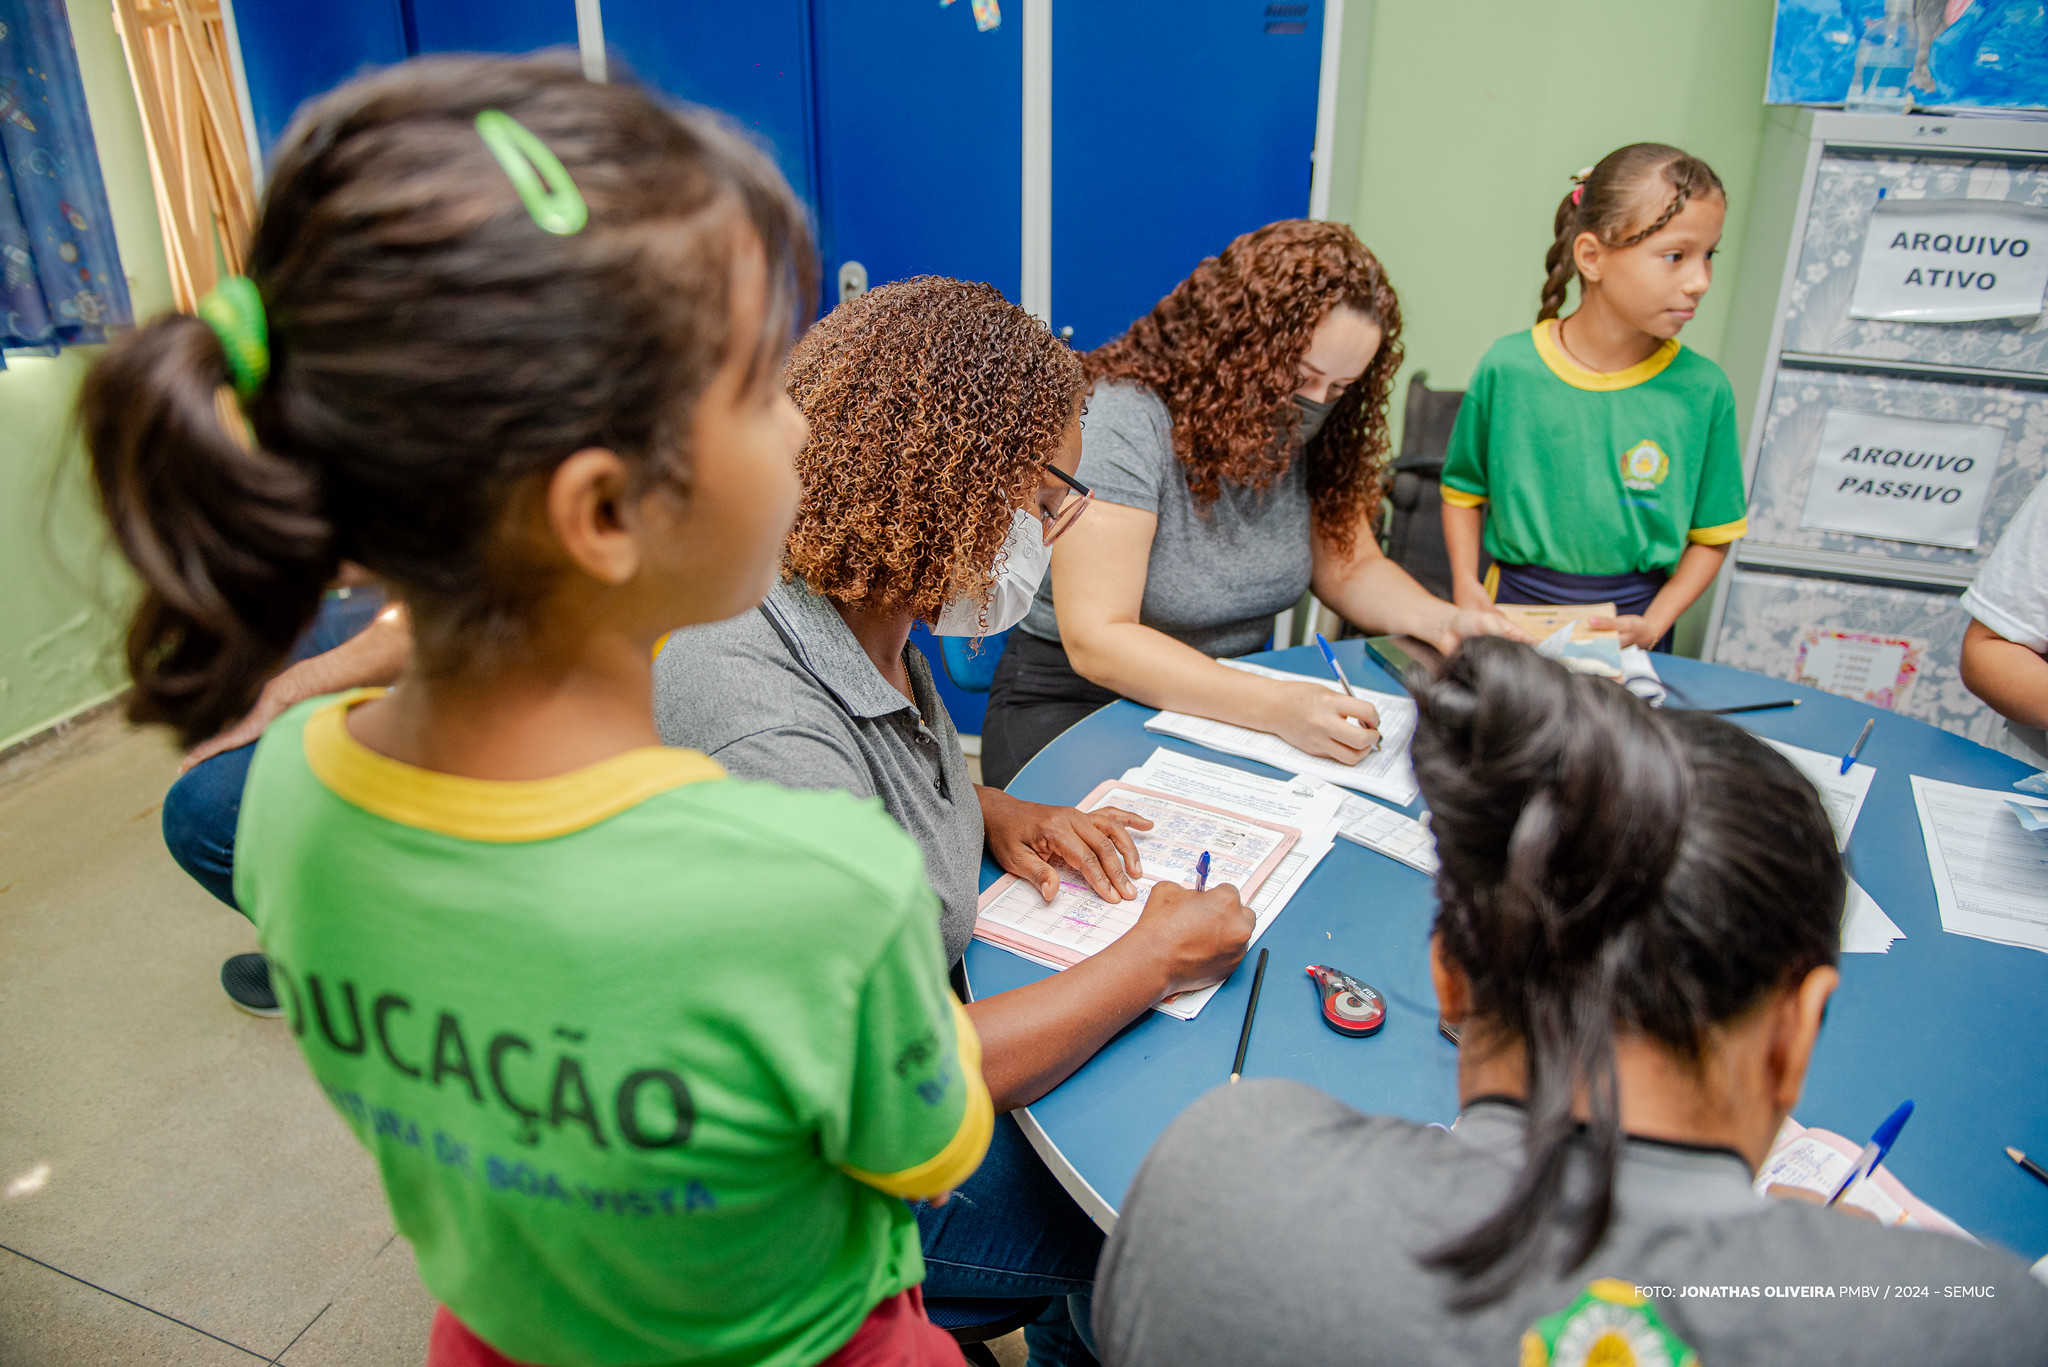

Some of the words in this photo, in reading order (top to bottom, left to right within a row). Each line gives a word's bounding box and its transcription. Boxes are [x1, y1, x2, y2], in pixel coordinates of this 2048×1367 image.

[1890, 232, 2029, 258] ARQUIVO
[1904, 268, 1996, 290] ATIVO
[1842, 446, 1975, 473] ARQUIVO
[1838, 477, 1962, 504] PASSIVO
